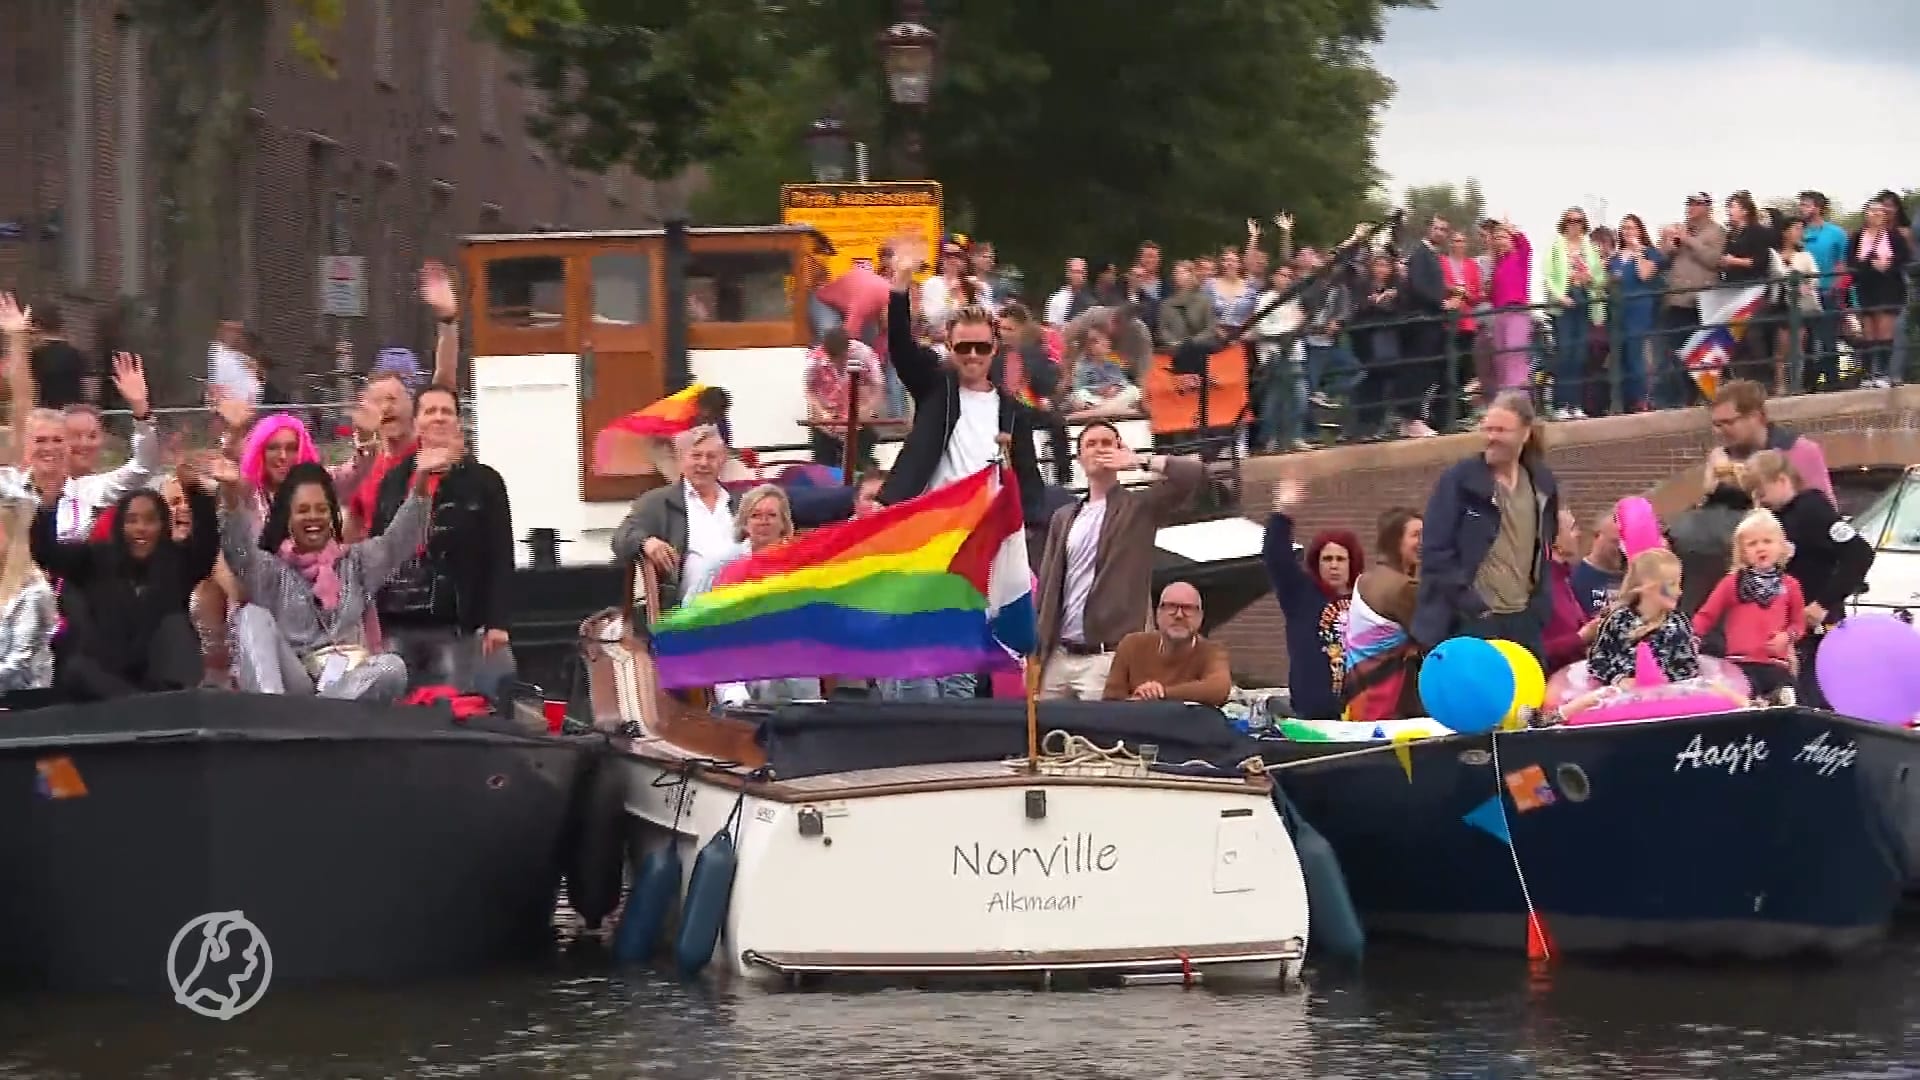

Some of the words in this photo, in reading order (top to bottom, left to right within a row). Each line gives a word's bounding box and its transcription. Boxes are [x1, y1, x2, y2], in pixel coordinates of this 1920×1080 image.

[1674, 734, 1770, 775] Aagje
[1792, 731, 1859, 776] Aagje
[953, 832, 1119, 877] Norville
[986, 890, 1083, 912] Alkmaar
